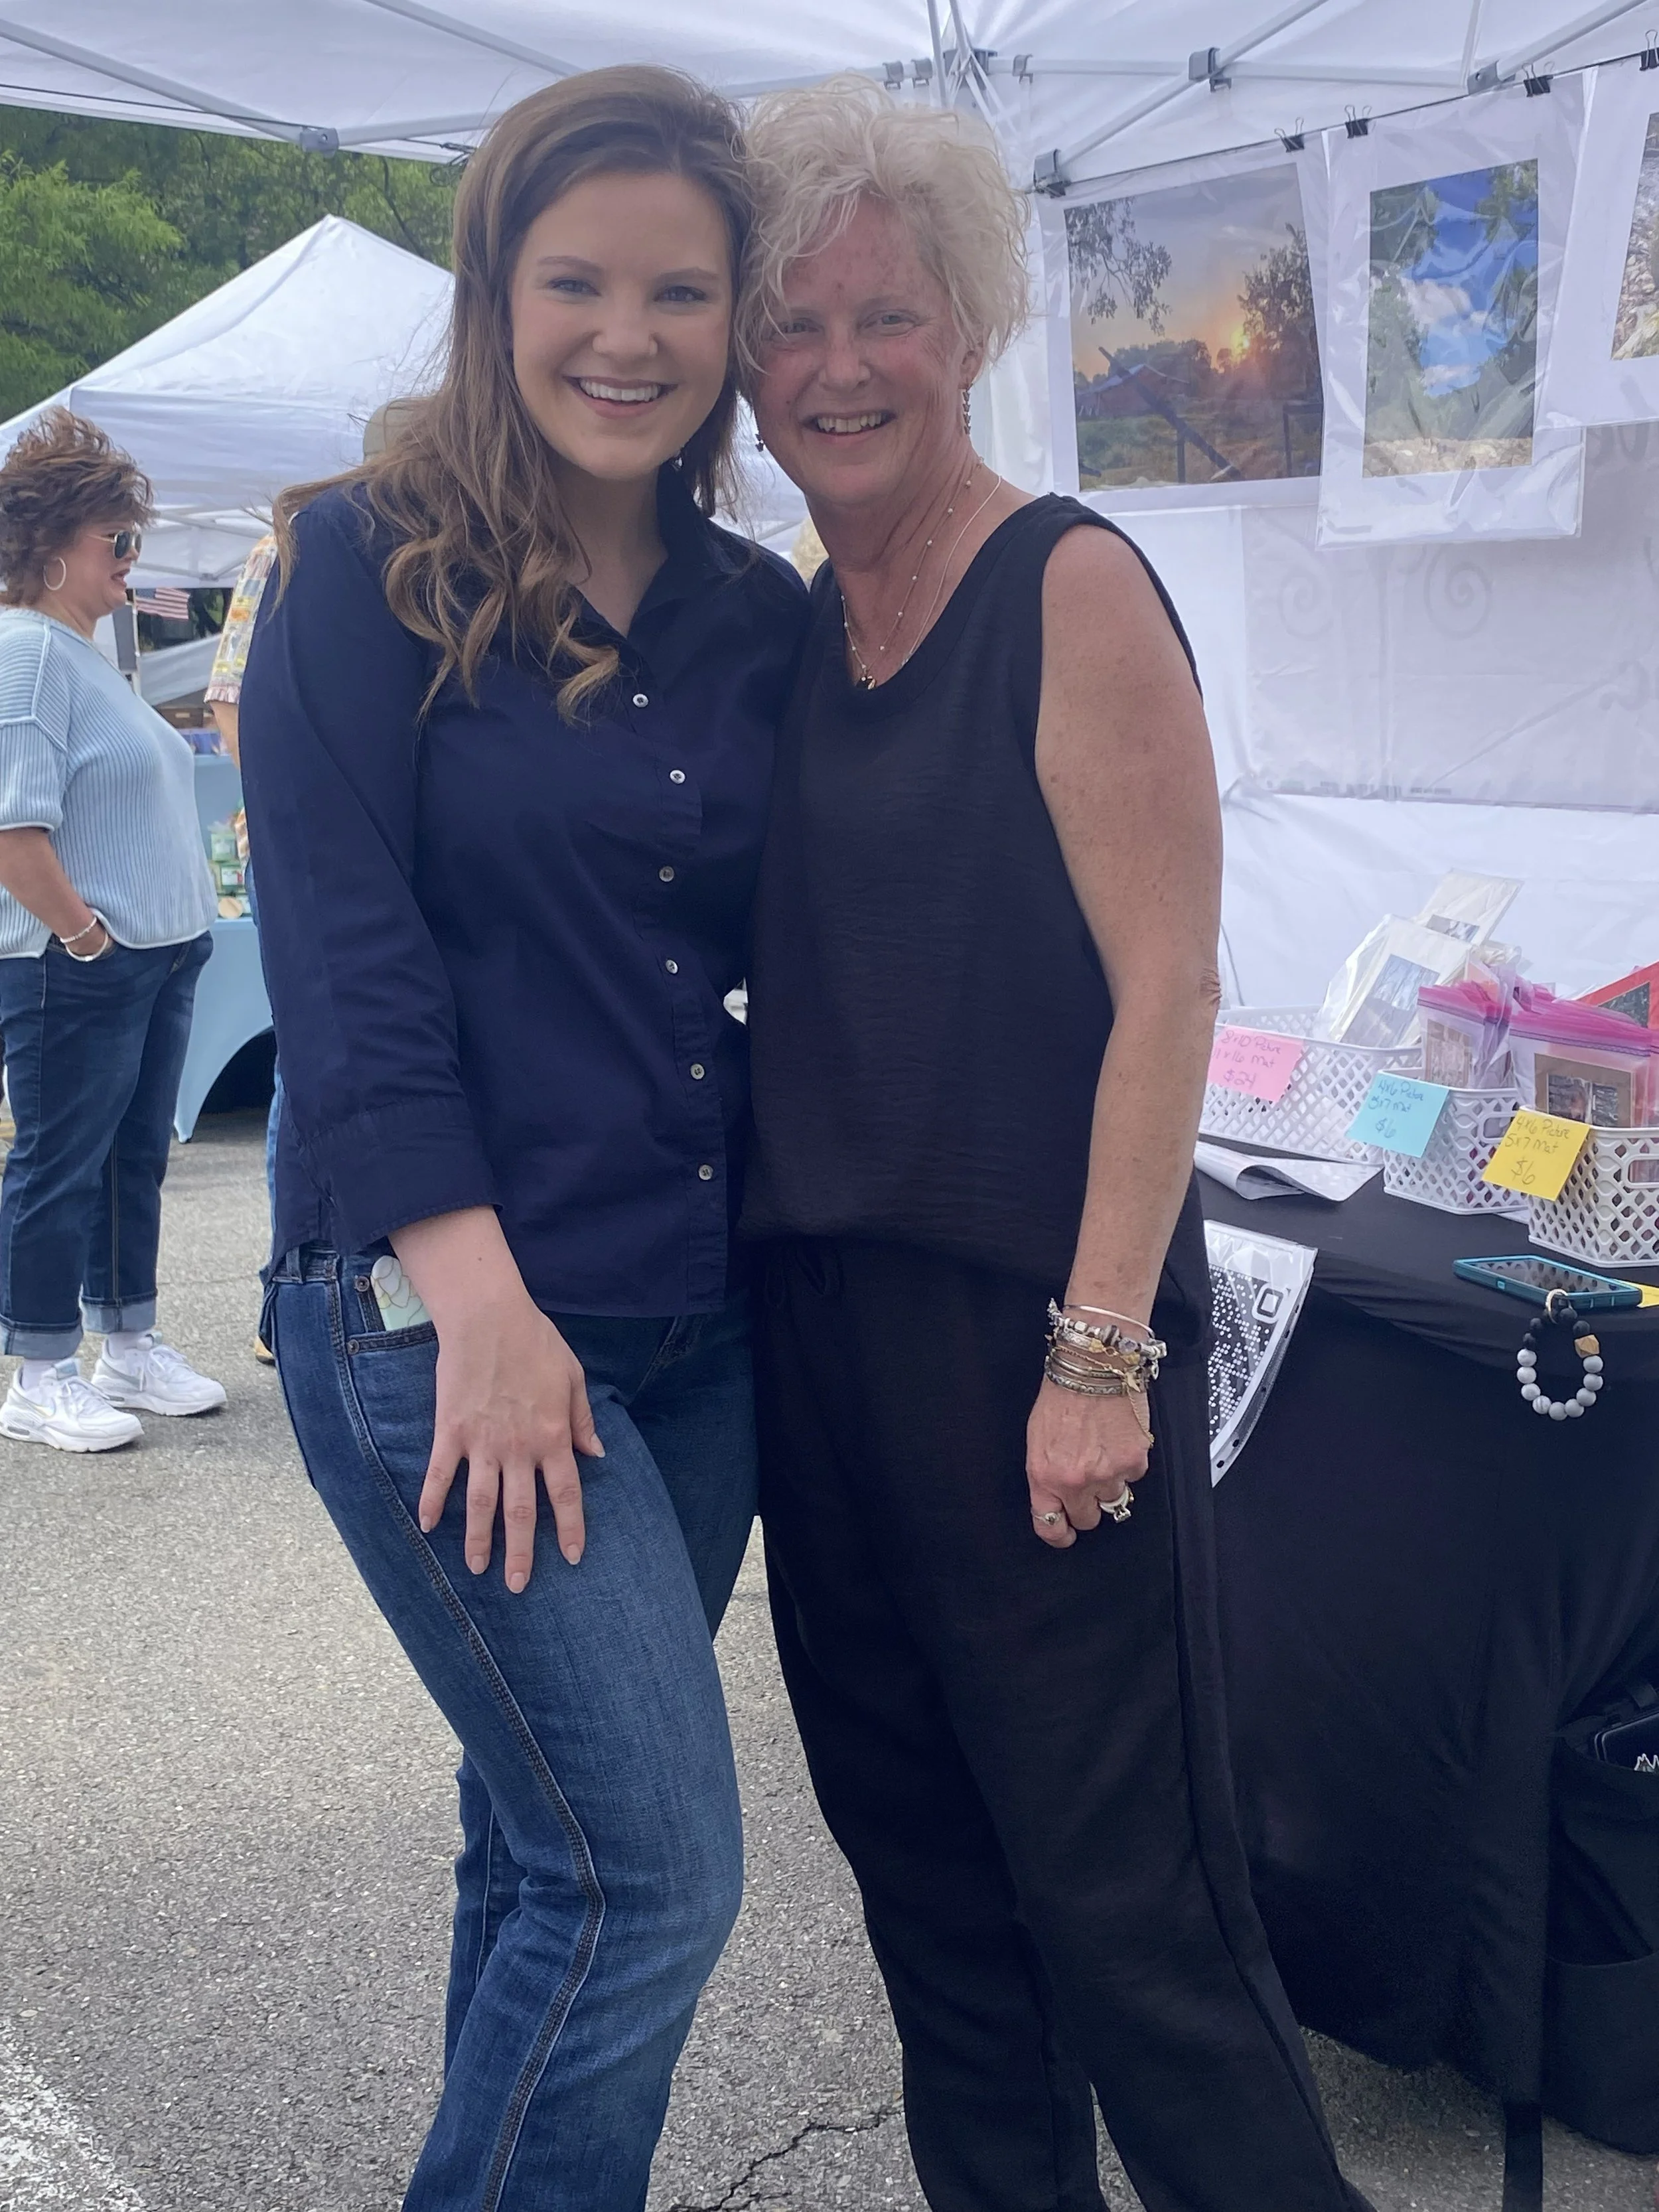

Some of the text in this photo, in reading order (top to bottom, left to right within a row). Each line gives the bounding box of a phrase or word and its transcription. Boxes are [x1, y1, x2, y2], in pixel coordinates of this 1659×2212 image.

[1223, 1069, 1257, 1089] $24
[1378, 1080, 1398, 1096] 4x6
[1375, 1118, 1396, 1139] $6
[1516, 1115, 1538, 1135] 4x6
[1504, 1133, 1532, 1150] 5x7
[1511, 1156, 1536, 1185] $6
